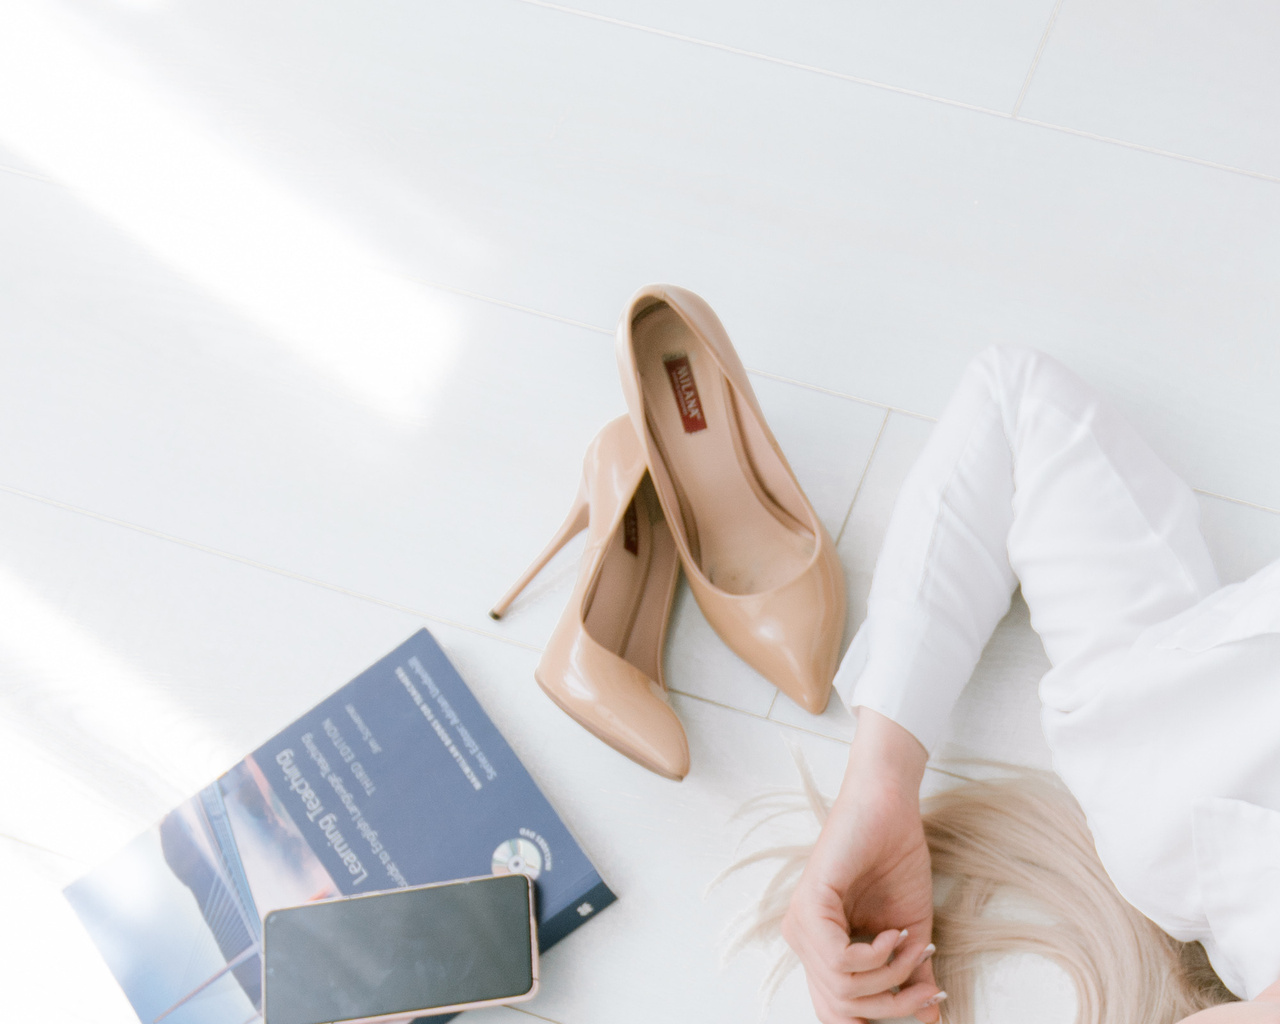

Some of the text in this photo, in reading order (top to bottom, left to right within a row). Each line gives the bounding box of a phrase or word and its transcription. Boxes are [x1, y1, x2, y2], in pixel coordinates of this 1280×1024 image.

[301, 732, 331, 778] Teaching
[322, 717, 376, 796] THIRD EDITION
[275, 748, 368, 885] Learning Teaching
[327, 773, 362, 821] Language
[356, 817, 383, 854] English
[379, 851, 390, 865] to
